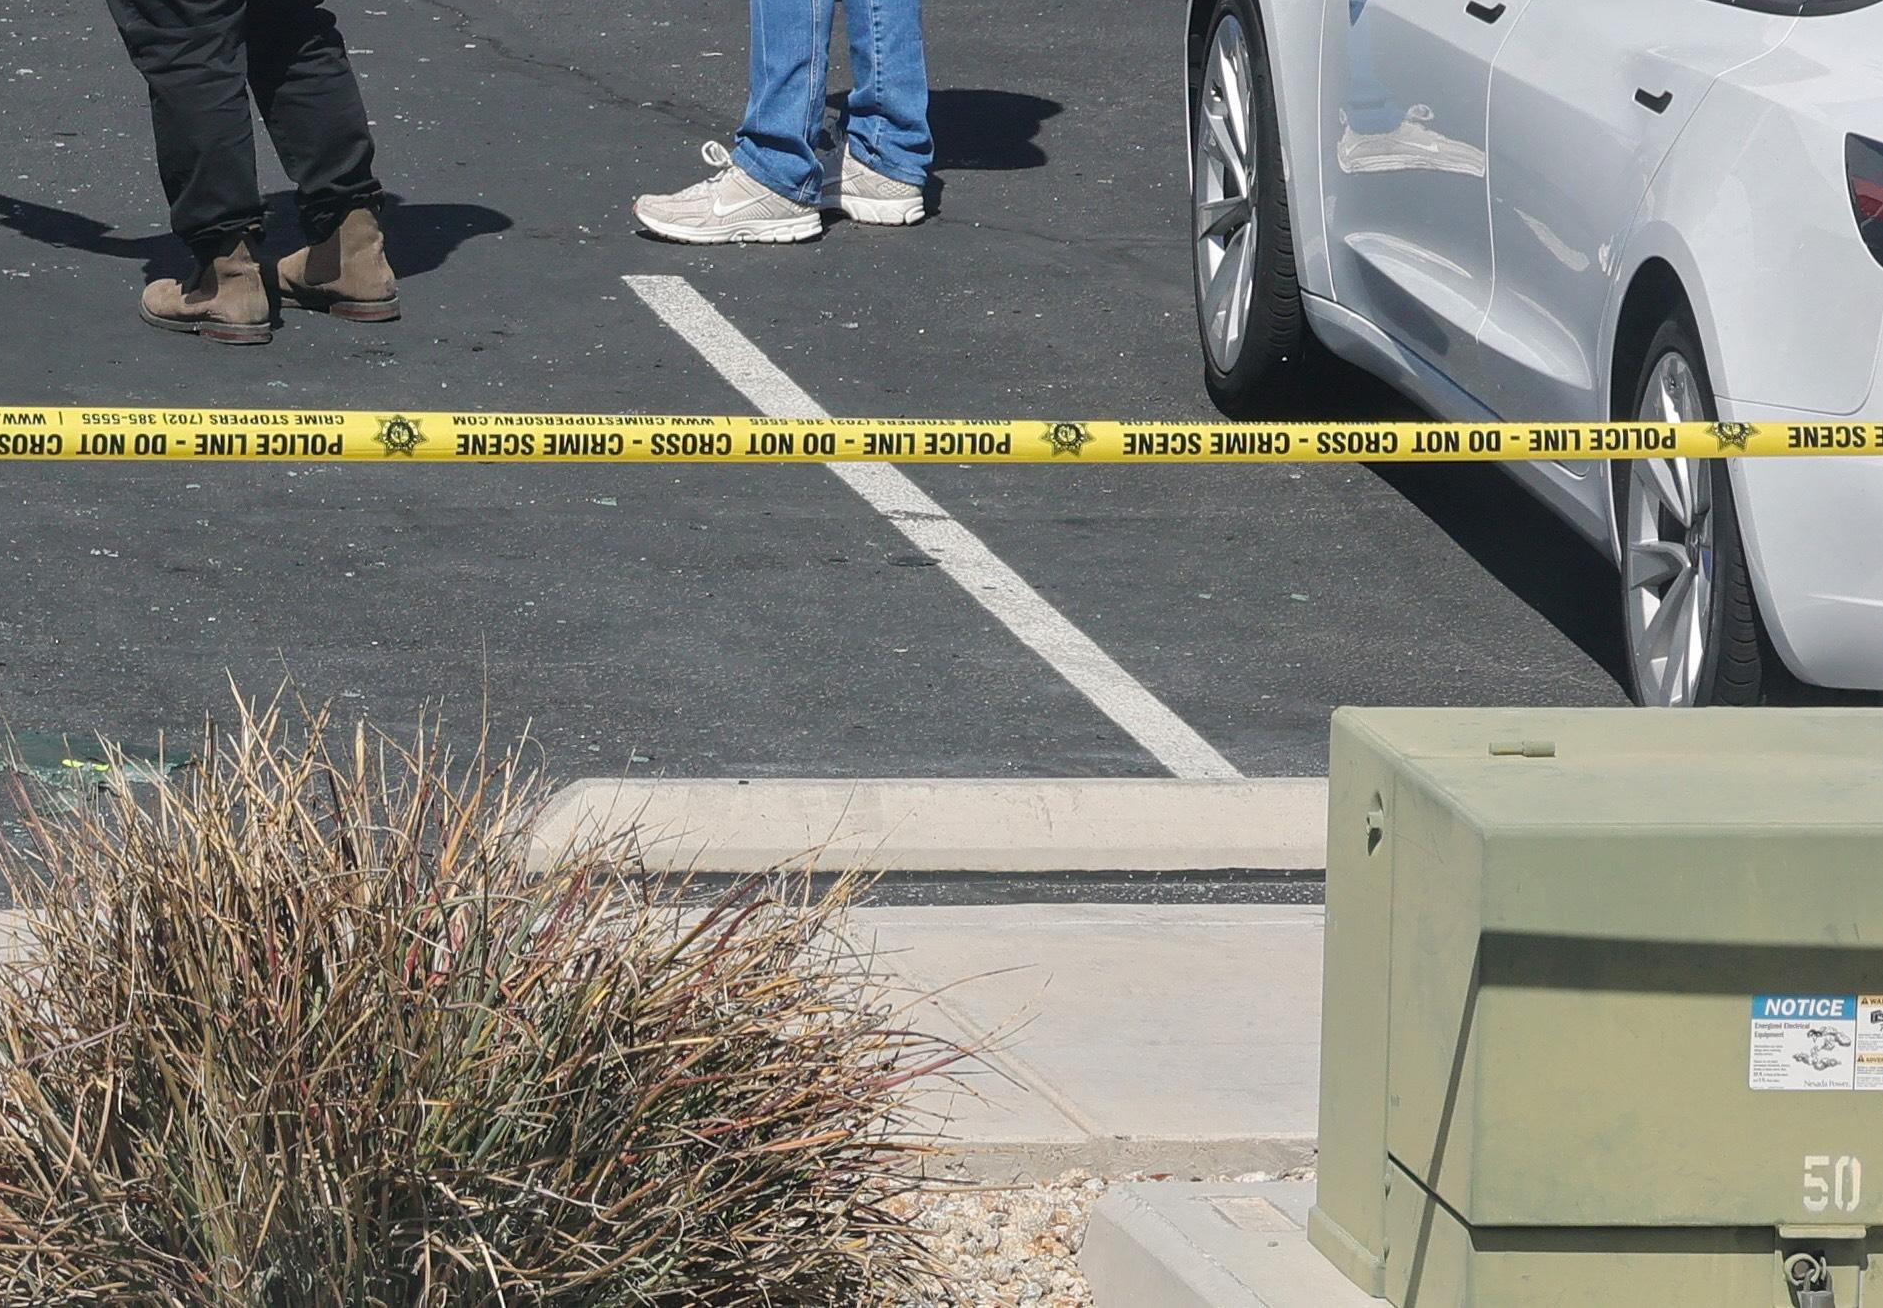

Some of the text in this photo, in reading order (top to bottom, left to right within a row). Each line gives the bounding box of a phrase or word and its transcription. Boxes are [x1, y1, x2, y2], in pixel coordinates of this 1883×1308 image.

[81, 413, 157, 425] 385-5555
[162, 413, 203, 425] (702)
[209, 414, 289, 425] STOPPERS
[295, 414, 345, 425] CRIME
[75, 433, 126, 456] NOT
[134, 433, 167, 456] DO
[193, 433, 247, 456] LINE
[255, 433, 343, 456] POLICE
[455, 432, 1011, 456] POLICE LINE DO NOT CROSS CRIME SCENE
[1122, 427, 1676, 456] POLICE LINE DO NOT CROSS CRIME SCENE
[1787, 425, 1867, 449] SCENE
[1765, 999, 1845, 1017] NOTICE
[1803, 1155, 1862, 1212] 50
